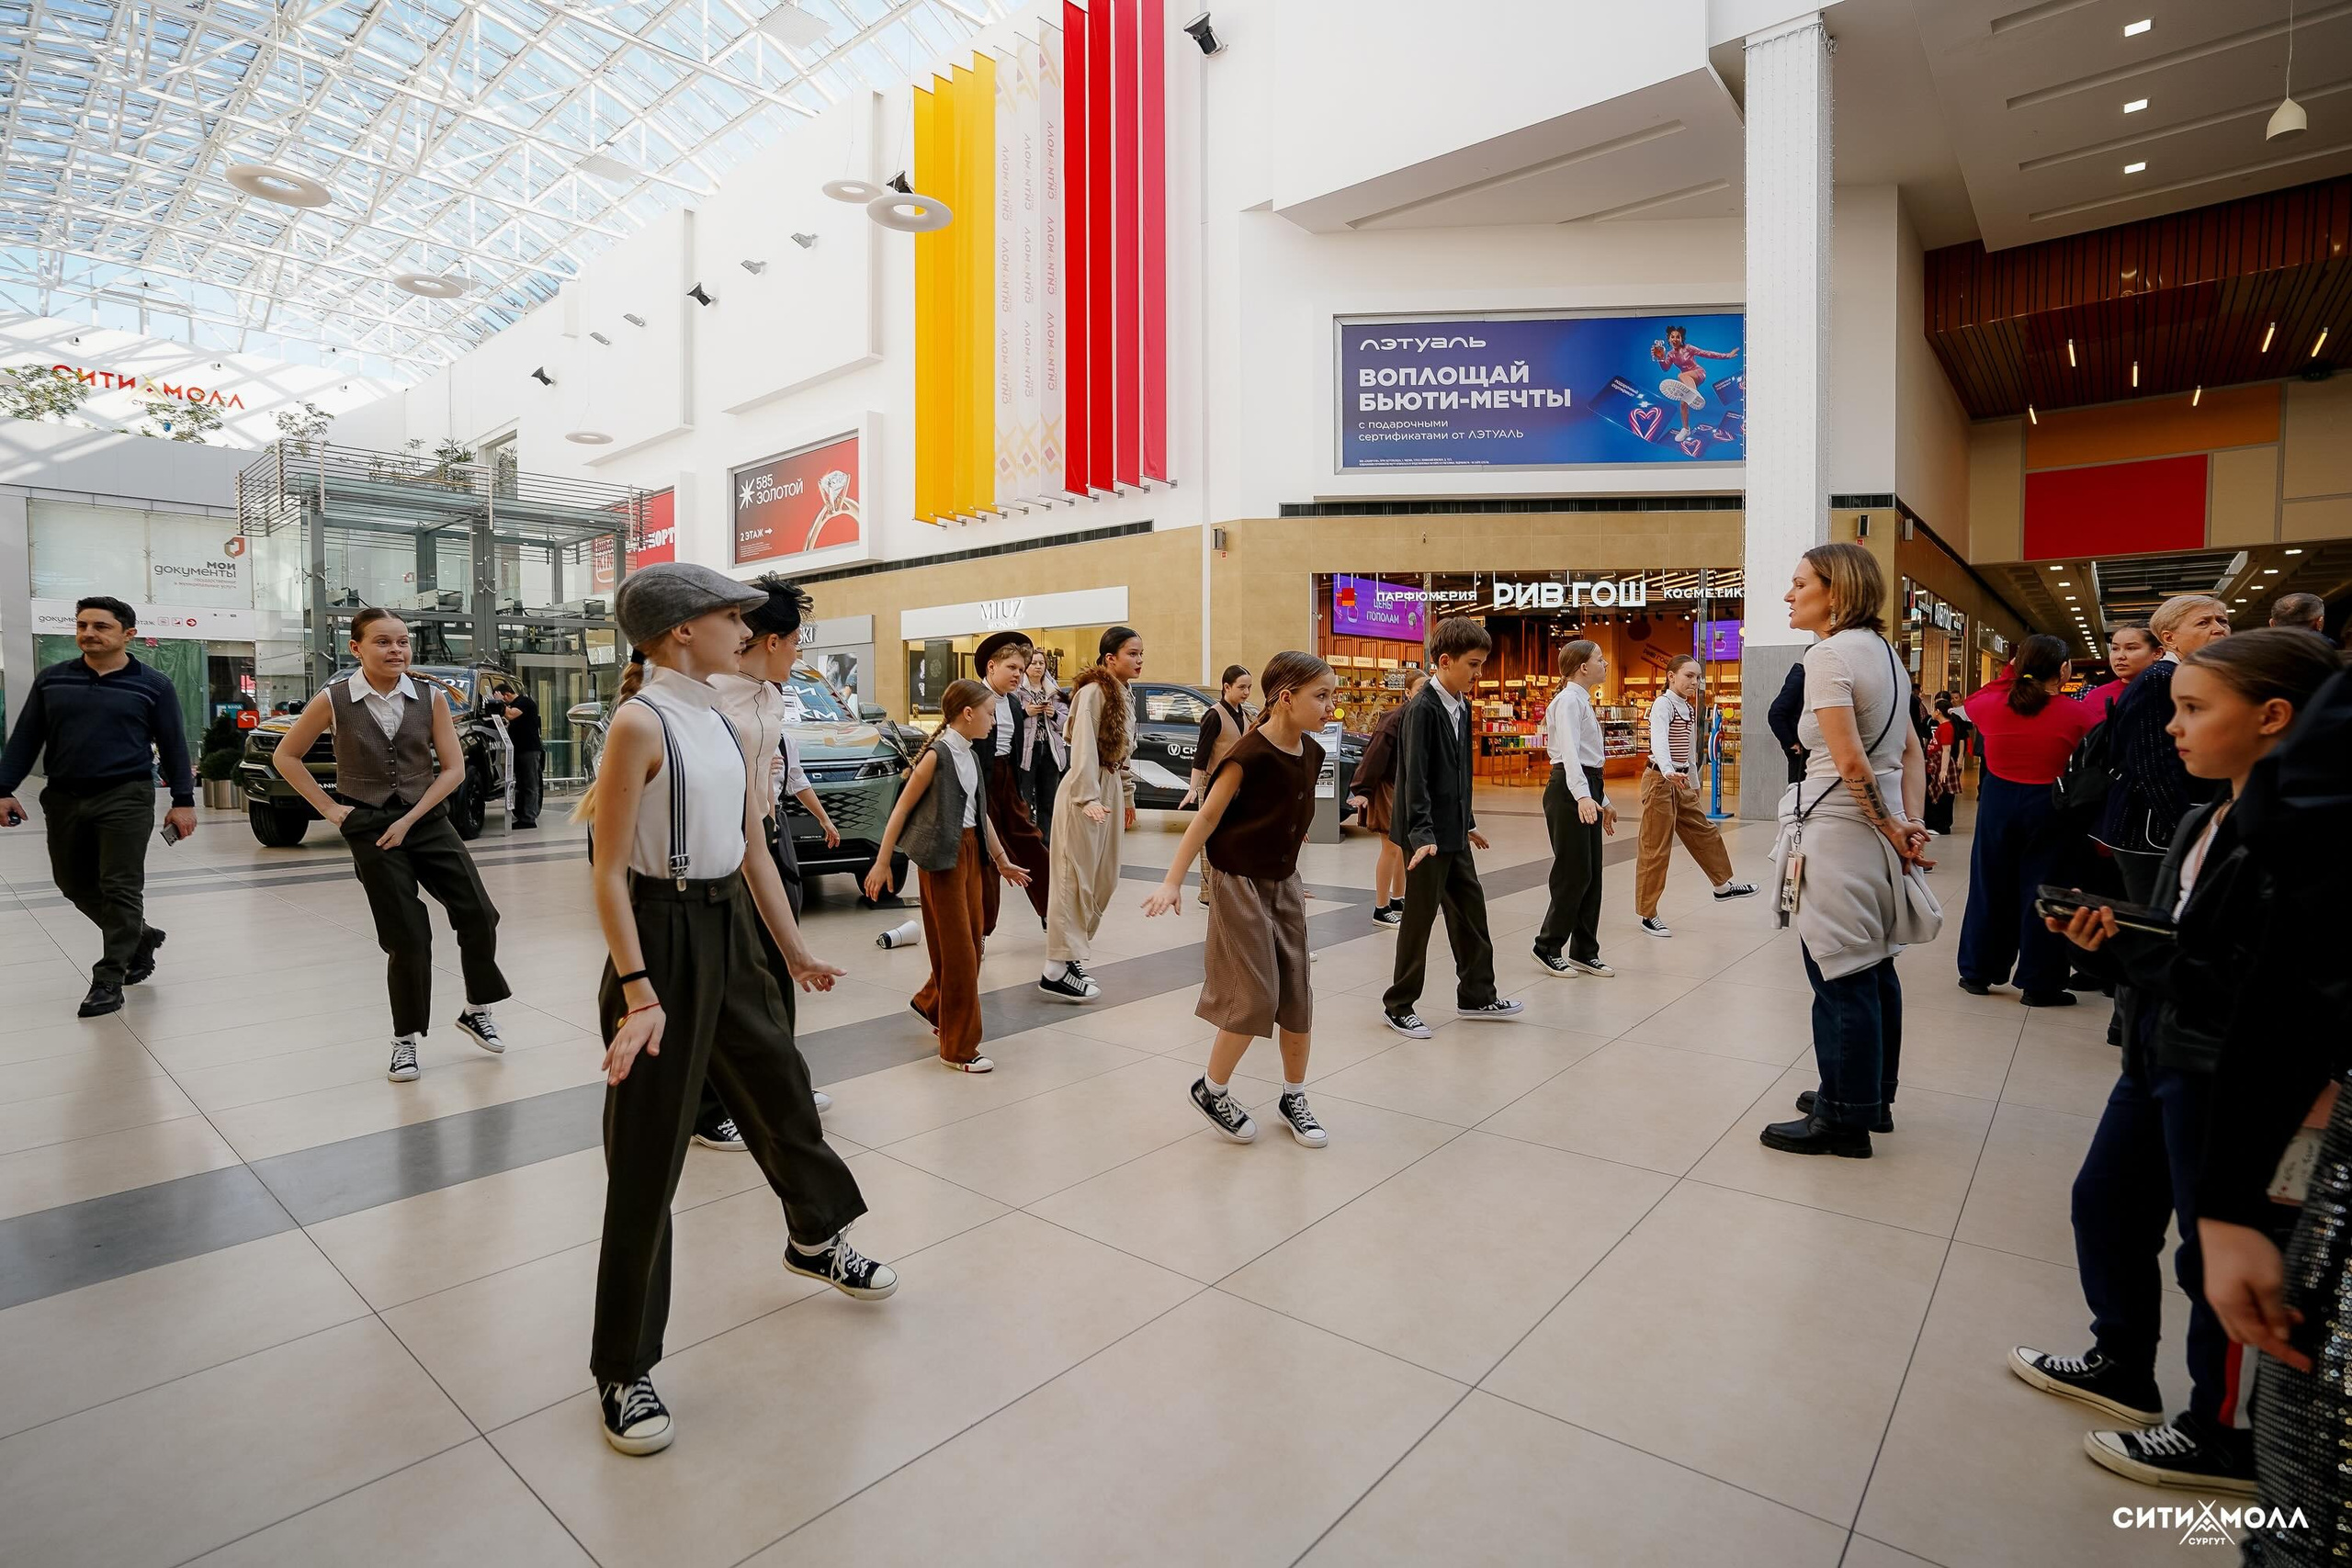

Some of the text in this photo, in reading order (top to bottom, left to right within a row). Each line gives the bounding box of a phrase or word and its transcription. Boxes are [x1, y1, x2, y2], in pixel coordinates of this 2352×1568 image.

[1359, 360, 1529, 387] ВОПЛОЩАЙ
[51, 365, 245, 410] СИТИ МОЛЛ
[1359, 389, 1571, 412] БЬЮТИ-МЕЧТЫ
[1368, 420, 1449, 432] подарочными
[1359, 432, 1449, 442] сертификатами
[1468, 429, 1524, 439] ЛЭТУАЛЬ
[756, 474, 774, 490] 585
[756, 478, 804, 504] ЗОЛОТОЙ
[740, 528, 764, 542] 2 ЭТАЖ
[154, 564, 236, 578] документы
[1376, 591, 1477, 602] ПАРФЮМЕРИЯ
[1494, 581, 1646, 608] РИВ ГОШ
[1664, 588, 1745, 599] КОСМЕТИК
[979, 599, 1022, 620] MIUZ
[1366, 611, 1399, 624] ПОПОЛАМ
